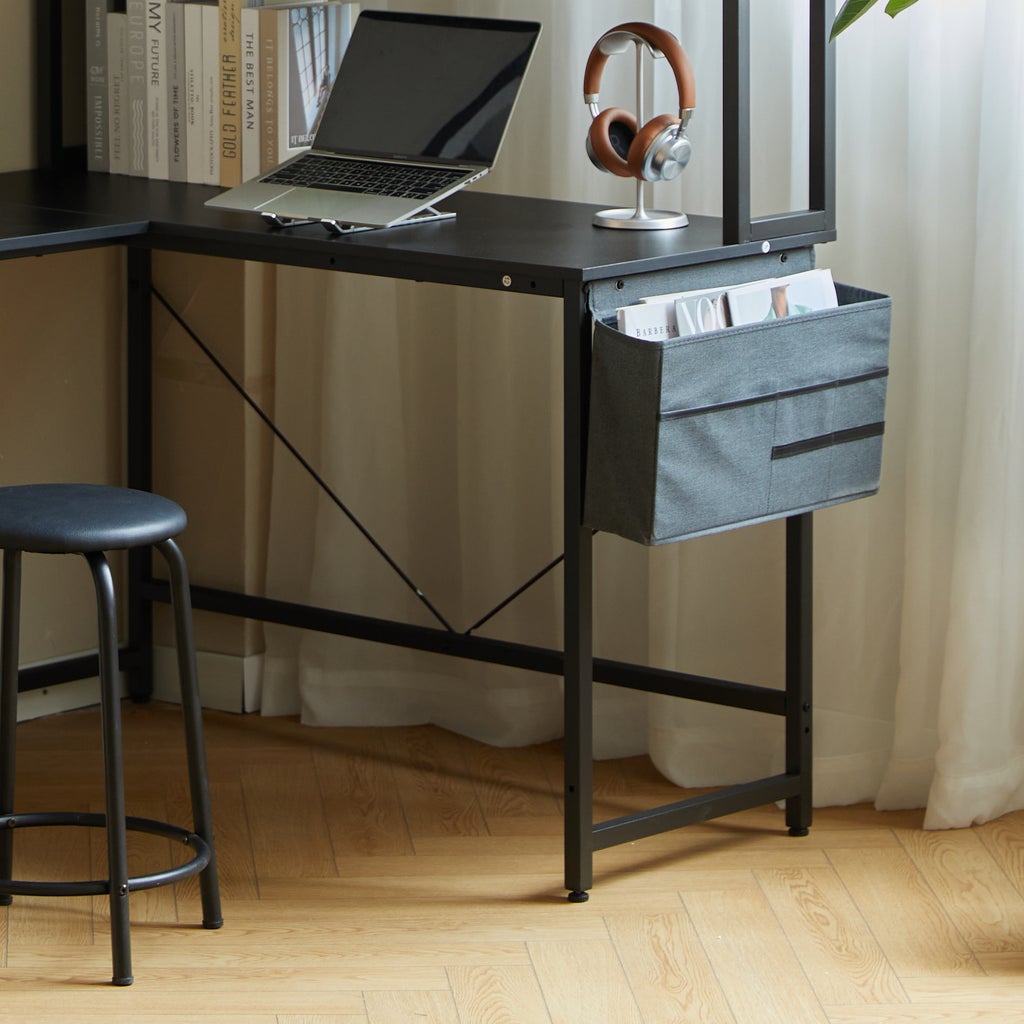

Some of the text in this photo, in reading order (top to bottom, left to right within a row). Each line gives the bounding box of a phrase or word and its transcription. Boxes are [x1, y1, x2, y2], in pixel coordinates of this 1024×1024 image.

[149, 1, 161, 34] MY
[128, 1, 144, 86] EUROPE
[151, 38, 161, 87] FUTURE
[222, 54, 238, 117] FEATHER
[245, 32, 255, 130] THE BEST MAN
[265, 57, 273, 113] BELONGS
[172, 122, 180, 163] FLOWERS
[223, 120, 237, 160] GOLD
[265, 119, 274, 133] TO
